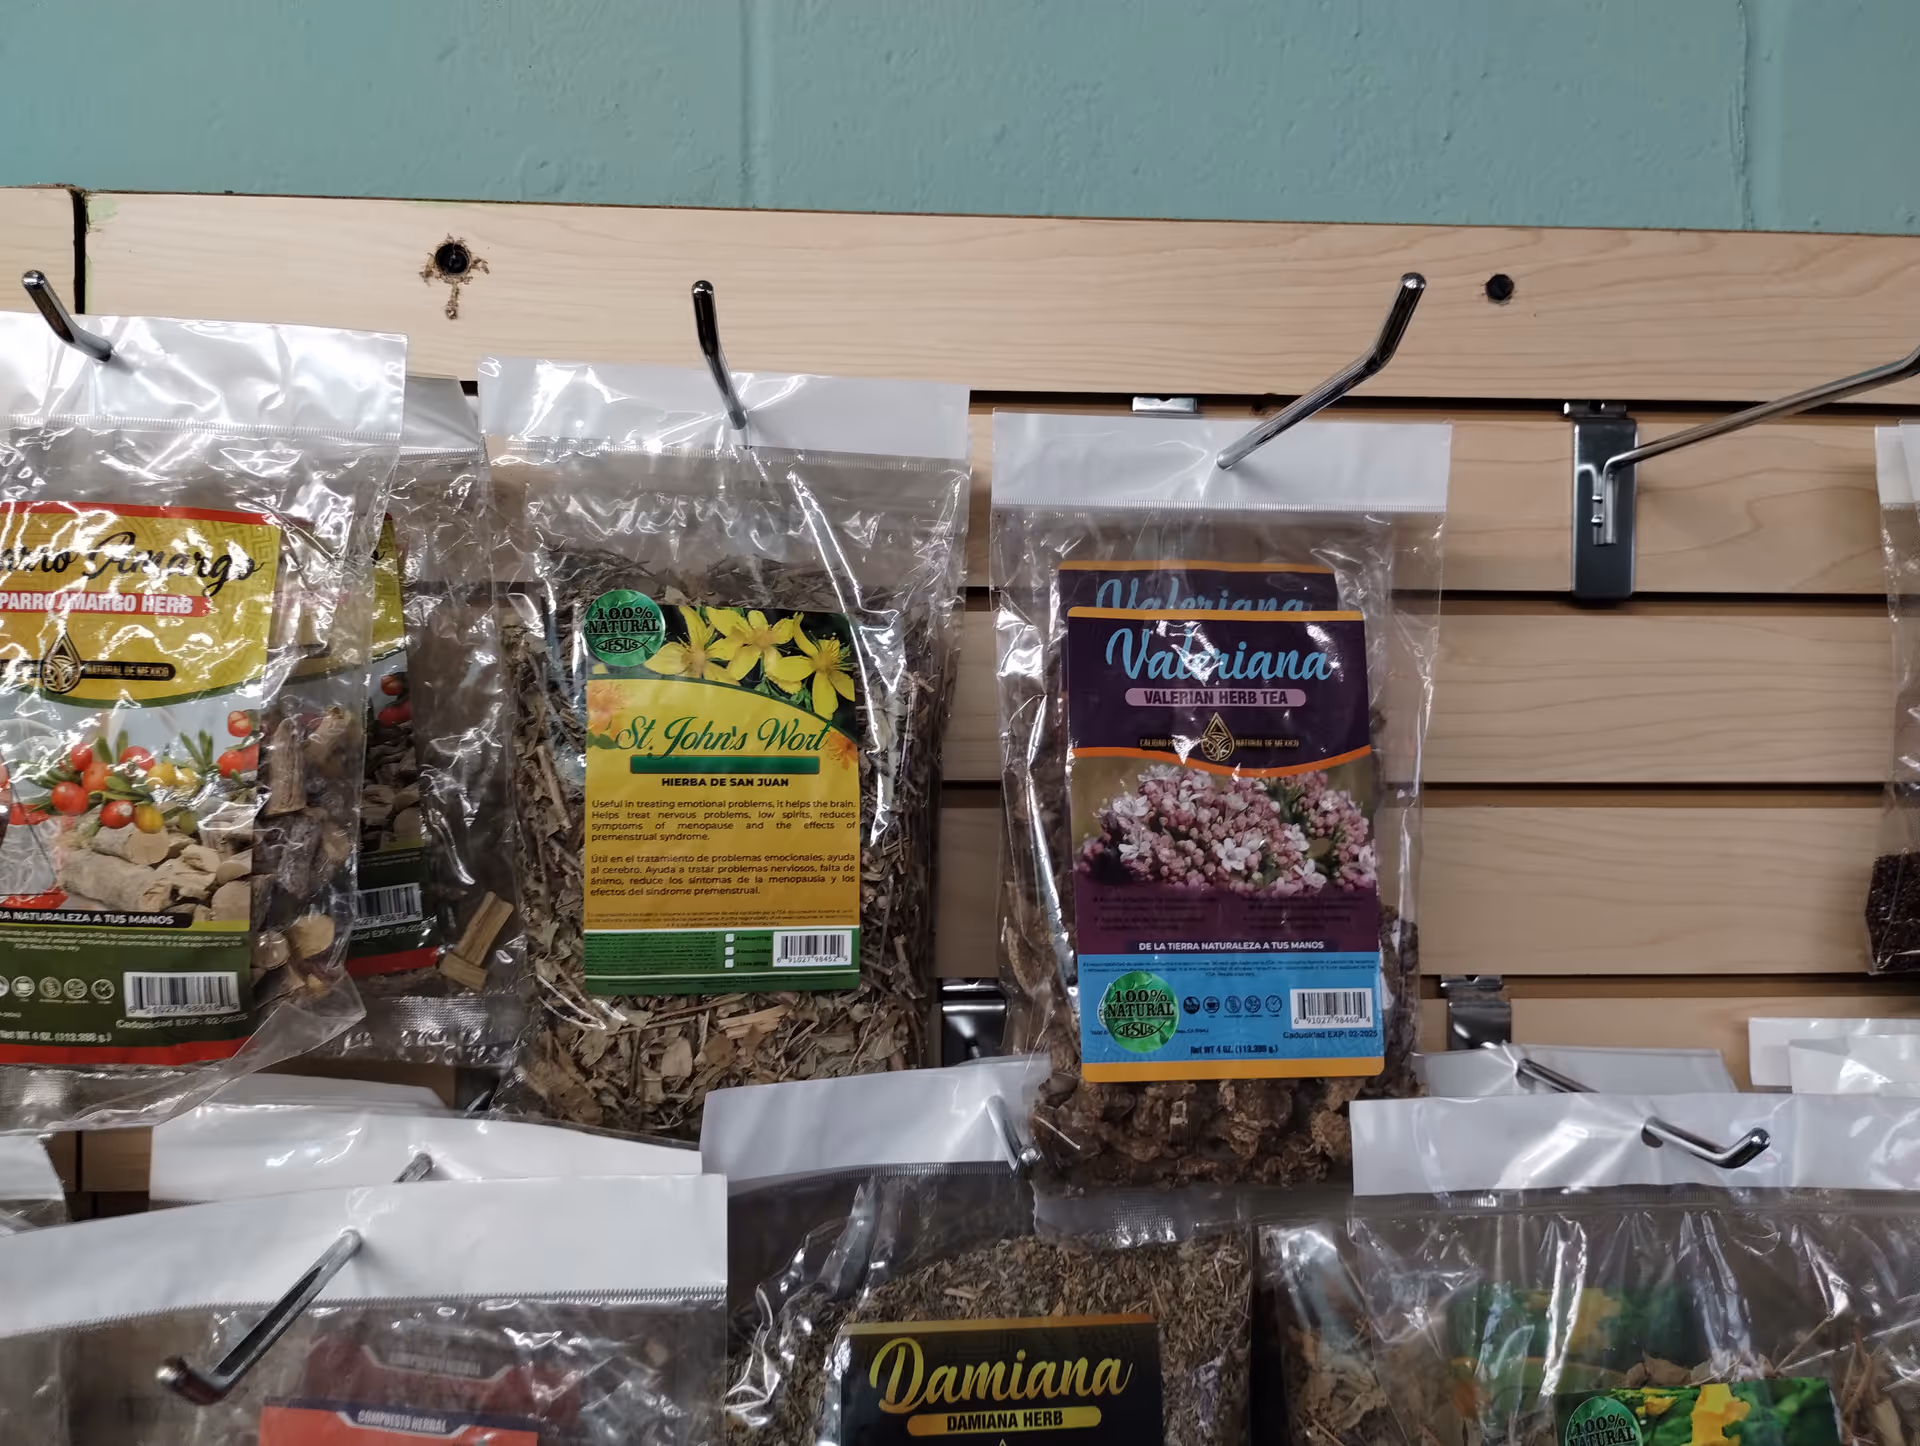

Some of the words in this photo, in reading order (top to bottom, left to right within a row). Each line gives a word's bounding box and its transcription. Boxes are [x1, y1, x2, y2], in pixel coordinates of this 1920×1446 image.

[82, 530, 265, 598] Amargo
[59, 593, 136, 613] AMARGO
[141, 594, 193, 614] HERB
[597, 606, 653, 620] 100%
[588, 618, 660, 633] NATURAL
[600, 639, 638, 652] JESUS
[1143, 690, 1214, 705] VALERIAN
[1218, 690, 1257, 705] HERB
[1260, 690, 1288, 705] TEA
[615, 715, 656, 751] St.
[646, 716, 748, 760] John's
[757, 717, 833, 751] Wort
[661, 777, 706, 787] HIERBA
[710, 777, 727, 787] DE
[730, 777, 754, 787] SAN
[757, 777, 789, 787] JUAN
[592, 799, 622, 808] Useful
[625, 800, 634, 808] in
[637, 800, 675, 809] treating
[678, 800, 726, 808] emotional
[728, 800, 775, 809] problems,
[777, 800, 783, 808] it
[785, 800, 810, 809] helps
[812, 800, 828, 808] the
[830, 800, 856, 808] brain.
[592, 811, 620, 820] Helps
[704, 811, 751, 820] problems,
[759, 811, 776, 819] low
[782, 811, 813, 820] spirits,
[820, 811, 856, 819] reduces
[592, 823, 643, 832] symptoms
[655, 822, 666, 830] of
[677, 823, 734, 831] menopause
[746, 822, 764, 830] and
[776, 822, 792, 830] the
[804, 821, 835, 830] effects
[846, 821, 856, 829] of
[592, 833, 657, 842] premenstrual
[660, 833, 710, 842] syndrome.
[591, 854, 608, 863] Útil
[625, 855, 634, 863] el
[637, 855, 695, 863] tratamiento
[697, 854, 709, 862] de
[711, 854, 761, 863] problemas
[764, 853, 825, 862] emocionales,
[827, 853, 855, 863] ayuda
[591, 866, 599, 874] al
[602, 866, 642, 874] cerebro.
[645, 866, 676, 875] Ayuda
[688, 866, 715, 874] tratar
[717, 865, 768, 874] problemas
[770, 865, 818, 873] nerviosos,
[820, 864, 840, 872] falta
[843, 864, 855, 872] de
[590, 877, 624, 886] ánimo,
[629, 877, 663, 885] reduce
[669, 876, 683, 885] los
[688, 876, 732, 884] síntomas
[737, 875, 750, 884] de
[755, 875, 763, 884] la
[768, 875, 826, 885] menopausia
[830, 876, 837, 884] y
[842, 875, 855, 883] los
[590, 888, 626, 896] efectos
[628, 887, 643, 896] del
[645, 887, 692, 896] síndrome
[694, 887, 760, 897] premenstrual.
[13, 911, 91, 923] NATURALEZA
[92, 914, 103, 923] A
[104, 914, 126, 924] TUS
[128, 915, 174, 925] MANOS
[1139, 942, 1152, 951] DE
[1153, 942, 1166, 951] LA
[1167, 942, 1200, 950] TIERRA
[1201, 941, 1261, 950] NATURALEZA
[1262, 941, 1270, 950] A
[1271, 941, 1289, 950] TUS
[1291, 941, 1324, 949] MANOS
[1114, 989, 1168, 1002] 100%
[1106, 1002, 1175, 1018] NATURAL
[1119, 1021, 1155, 1036] JESUS
[869, 1337, 1134, 1414] Damiana
[946, 1412, 1018, 1431] DAMIANA
[1023, 1410, 1063, 1428] HERB
[1573, 1412, 1627, 1436] 100%
[1568, 1426, 1637, 1446] NATURAL
